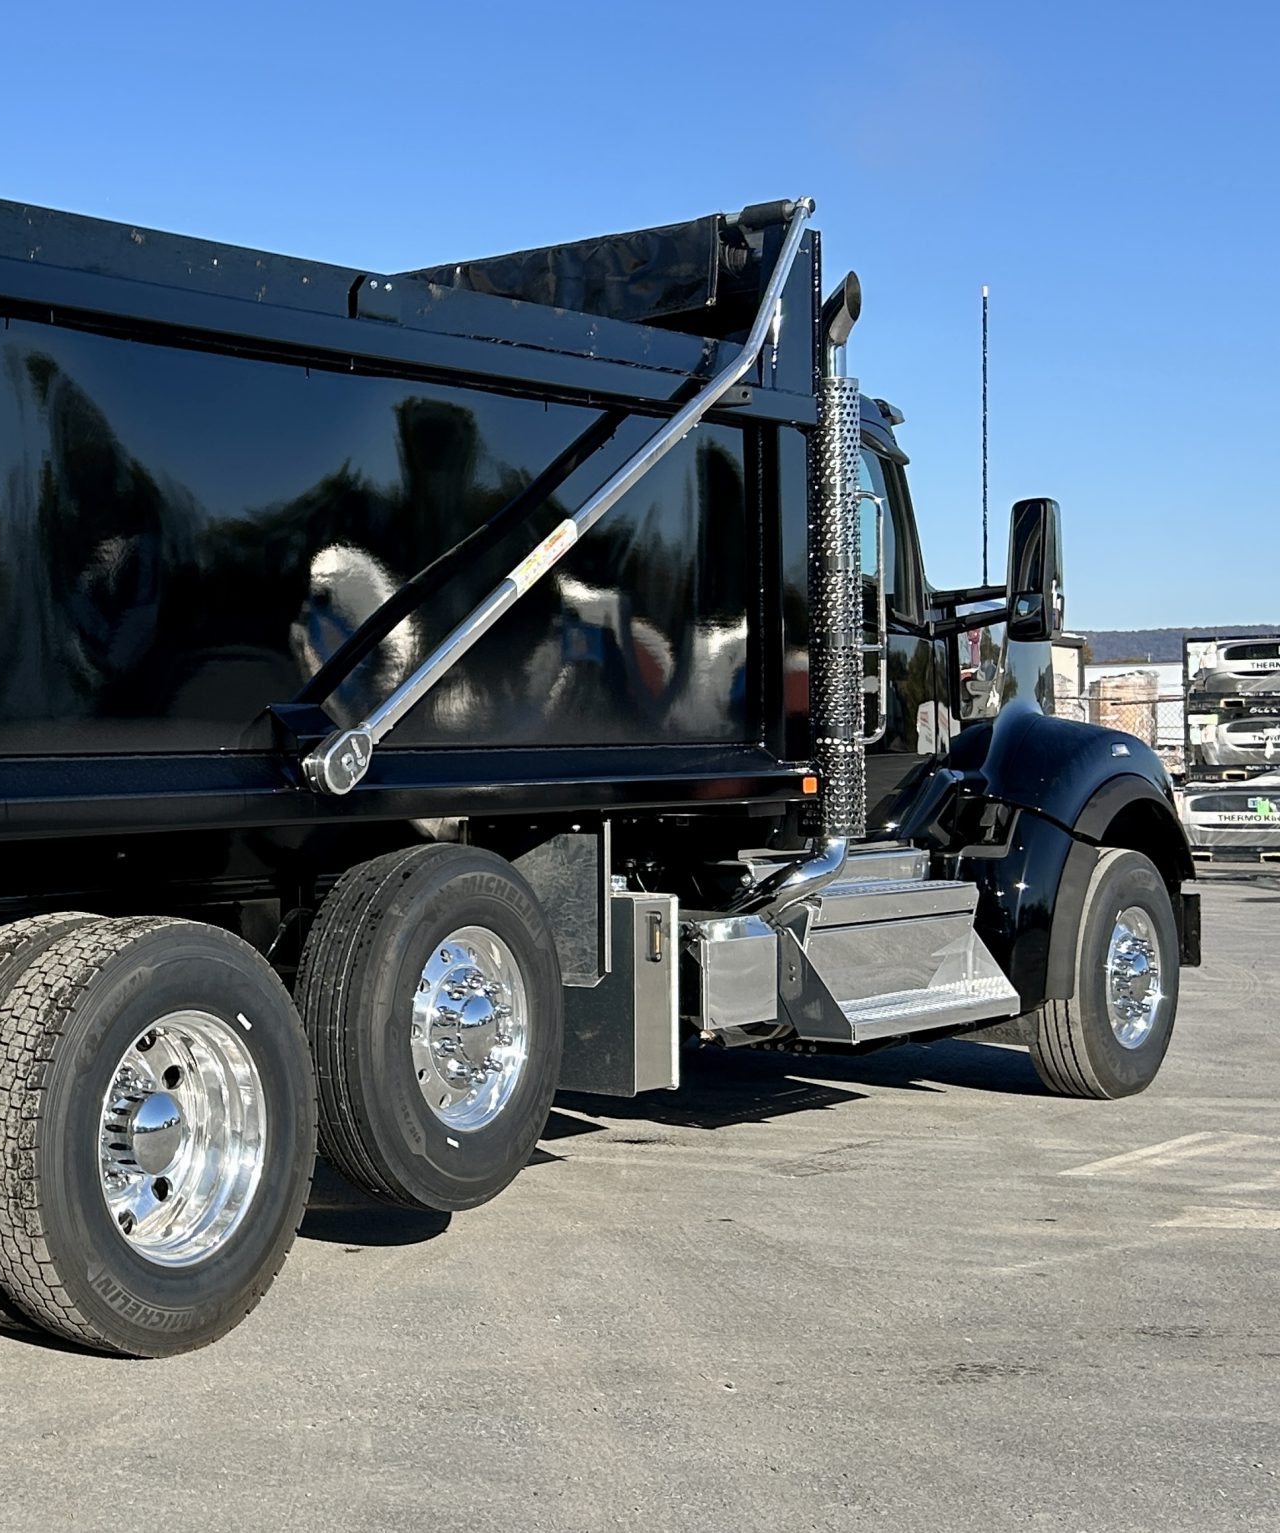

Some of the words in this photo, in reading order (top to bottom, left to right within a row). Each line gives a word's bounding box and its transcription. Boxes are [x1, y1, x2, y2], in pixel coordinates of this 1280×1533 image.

[1218, 814, 1261, 822] THERMO
[462, 875, 543, 930] MICHELIN
[96, 1276, 193, 1329] MICHELIN
